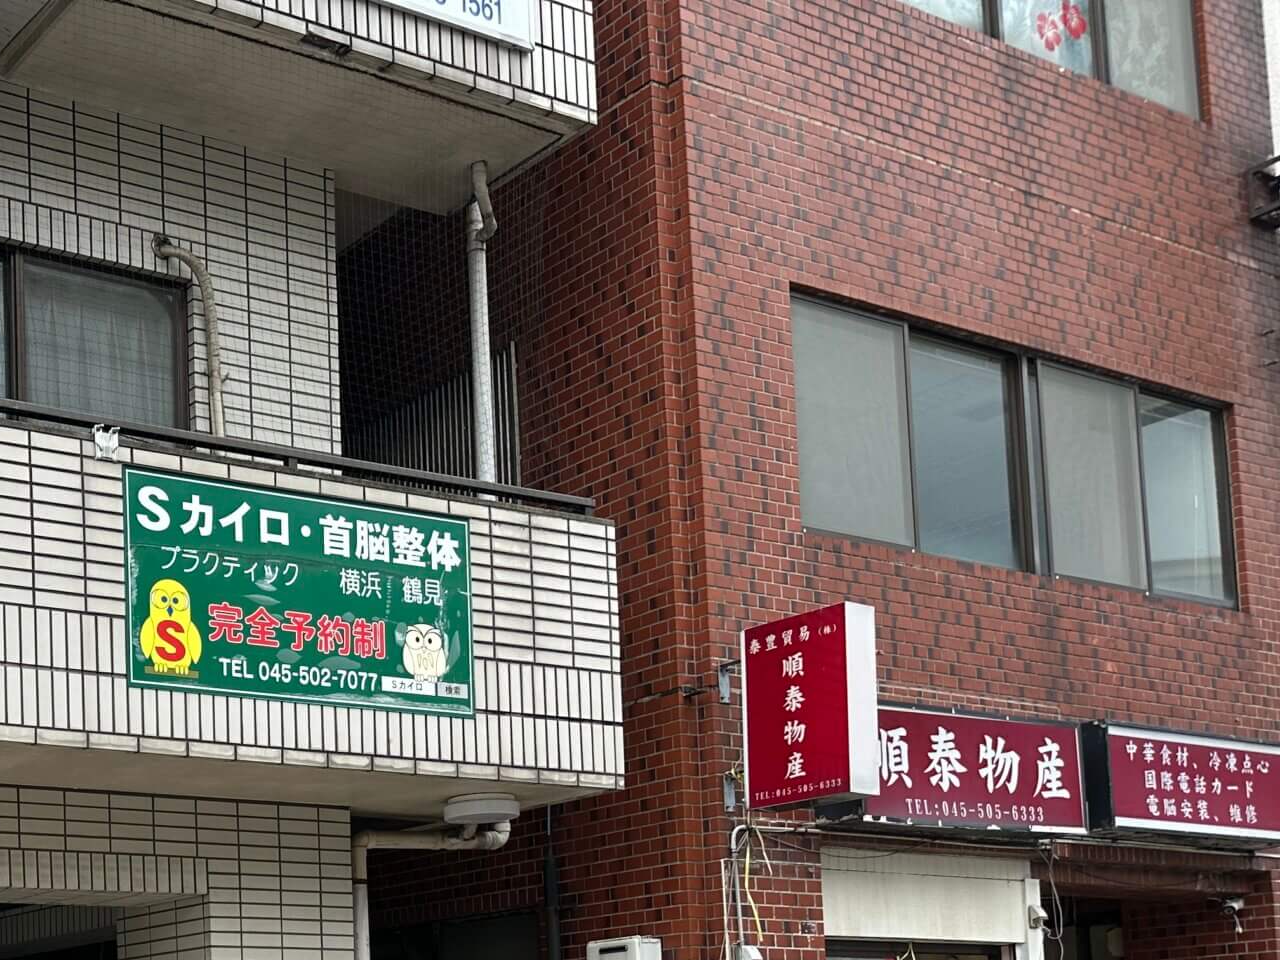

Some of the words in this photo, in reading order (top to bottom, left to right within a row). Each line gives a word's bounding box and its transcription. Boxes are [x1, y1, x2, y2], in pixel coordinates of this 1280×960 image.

[339, 568, 382, 599] 横浜
[208, 602, 387, 660] 完全予約制
[219, 658, 254, 680] TEL
[260, 661, 378, 691] 045-502-7077
[782, 652, 807, 780] 順泰物産
[1144, 769, 1254, 799] 国際電話カード
